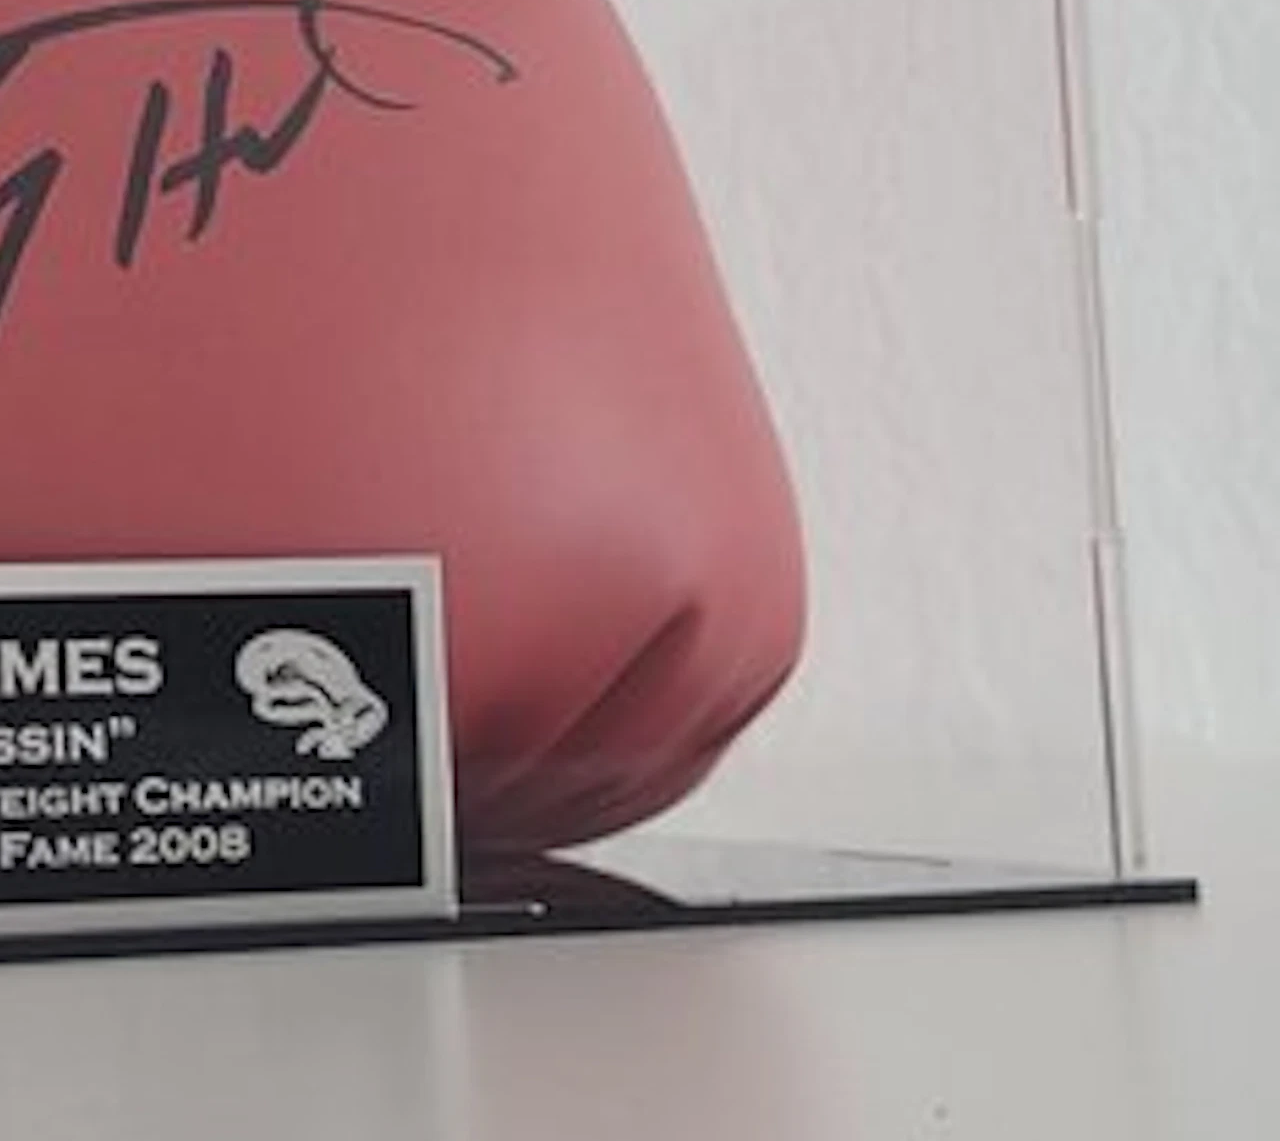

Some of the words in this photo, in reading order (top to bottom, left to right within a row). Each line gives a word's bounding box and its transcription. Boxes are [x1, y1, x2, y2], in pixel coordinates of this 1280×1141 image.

[135, 774, 363, 816] CHAMPION
[0, 830, 120, 870] FAME
[130, 824, 252, 865] 2008
